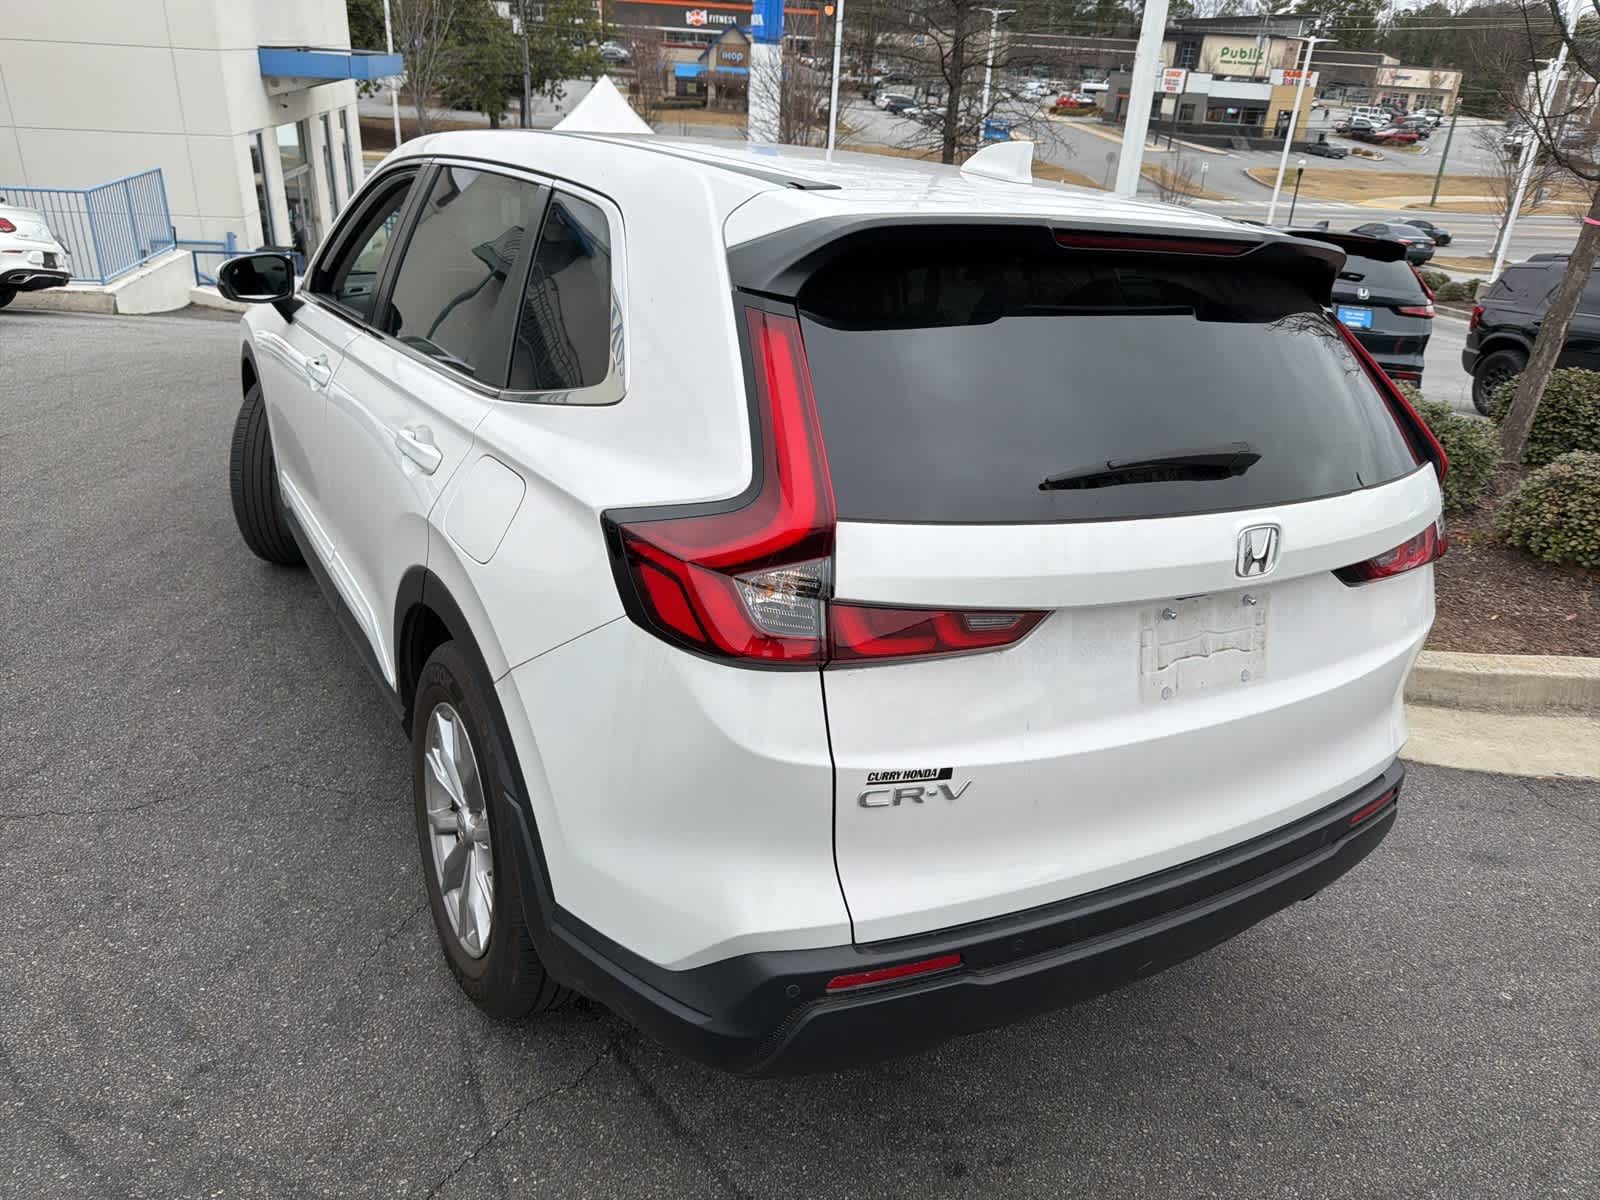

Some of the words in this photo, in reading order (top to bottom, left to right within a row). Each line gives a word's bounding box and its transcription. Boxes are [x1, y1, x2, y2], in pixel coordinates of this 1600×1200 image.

[708, 14, 737, 24] FITNESS
[867, 770, 903, 782] CURRY
[903, 768, 938, 780] HONDA
[857, 779, 972, 808] CR-V
